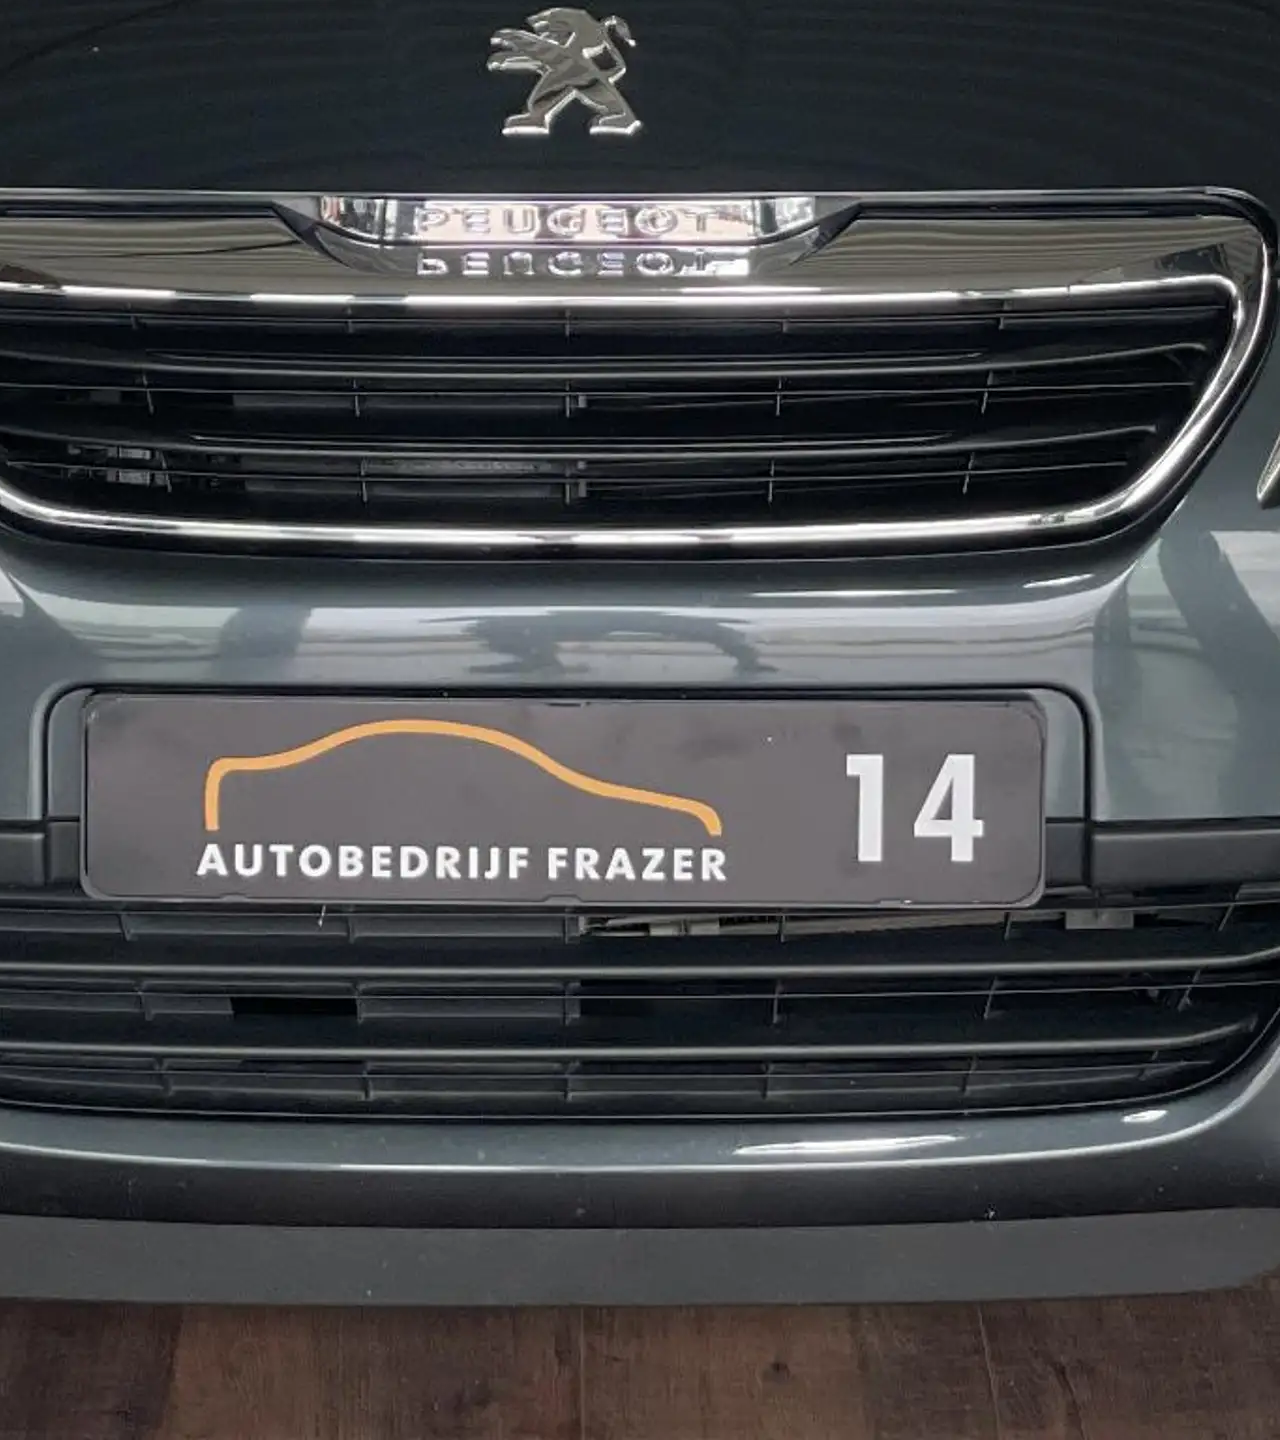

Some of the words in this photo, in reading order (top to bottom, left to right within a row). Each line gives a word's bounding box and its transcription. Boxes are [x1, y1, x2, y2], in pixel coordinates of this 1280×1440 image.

[415, 205, 713, 237] PEUGEOT
[845, 753, 984, 862] 14
[196, 842, 530, 879] AUTOBEDRIJF
[546, 845, 728, 881] FRAZER
